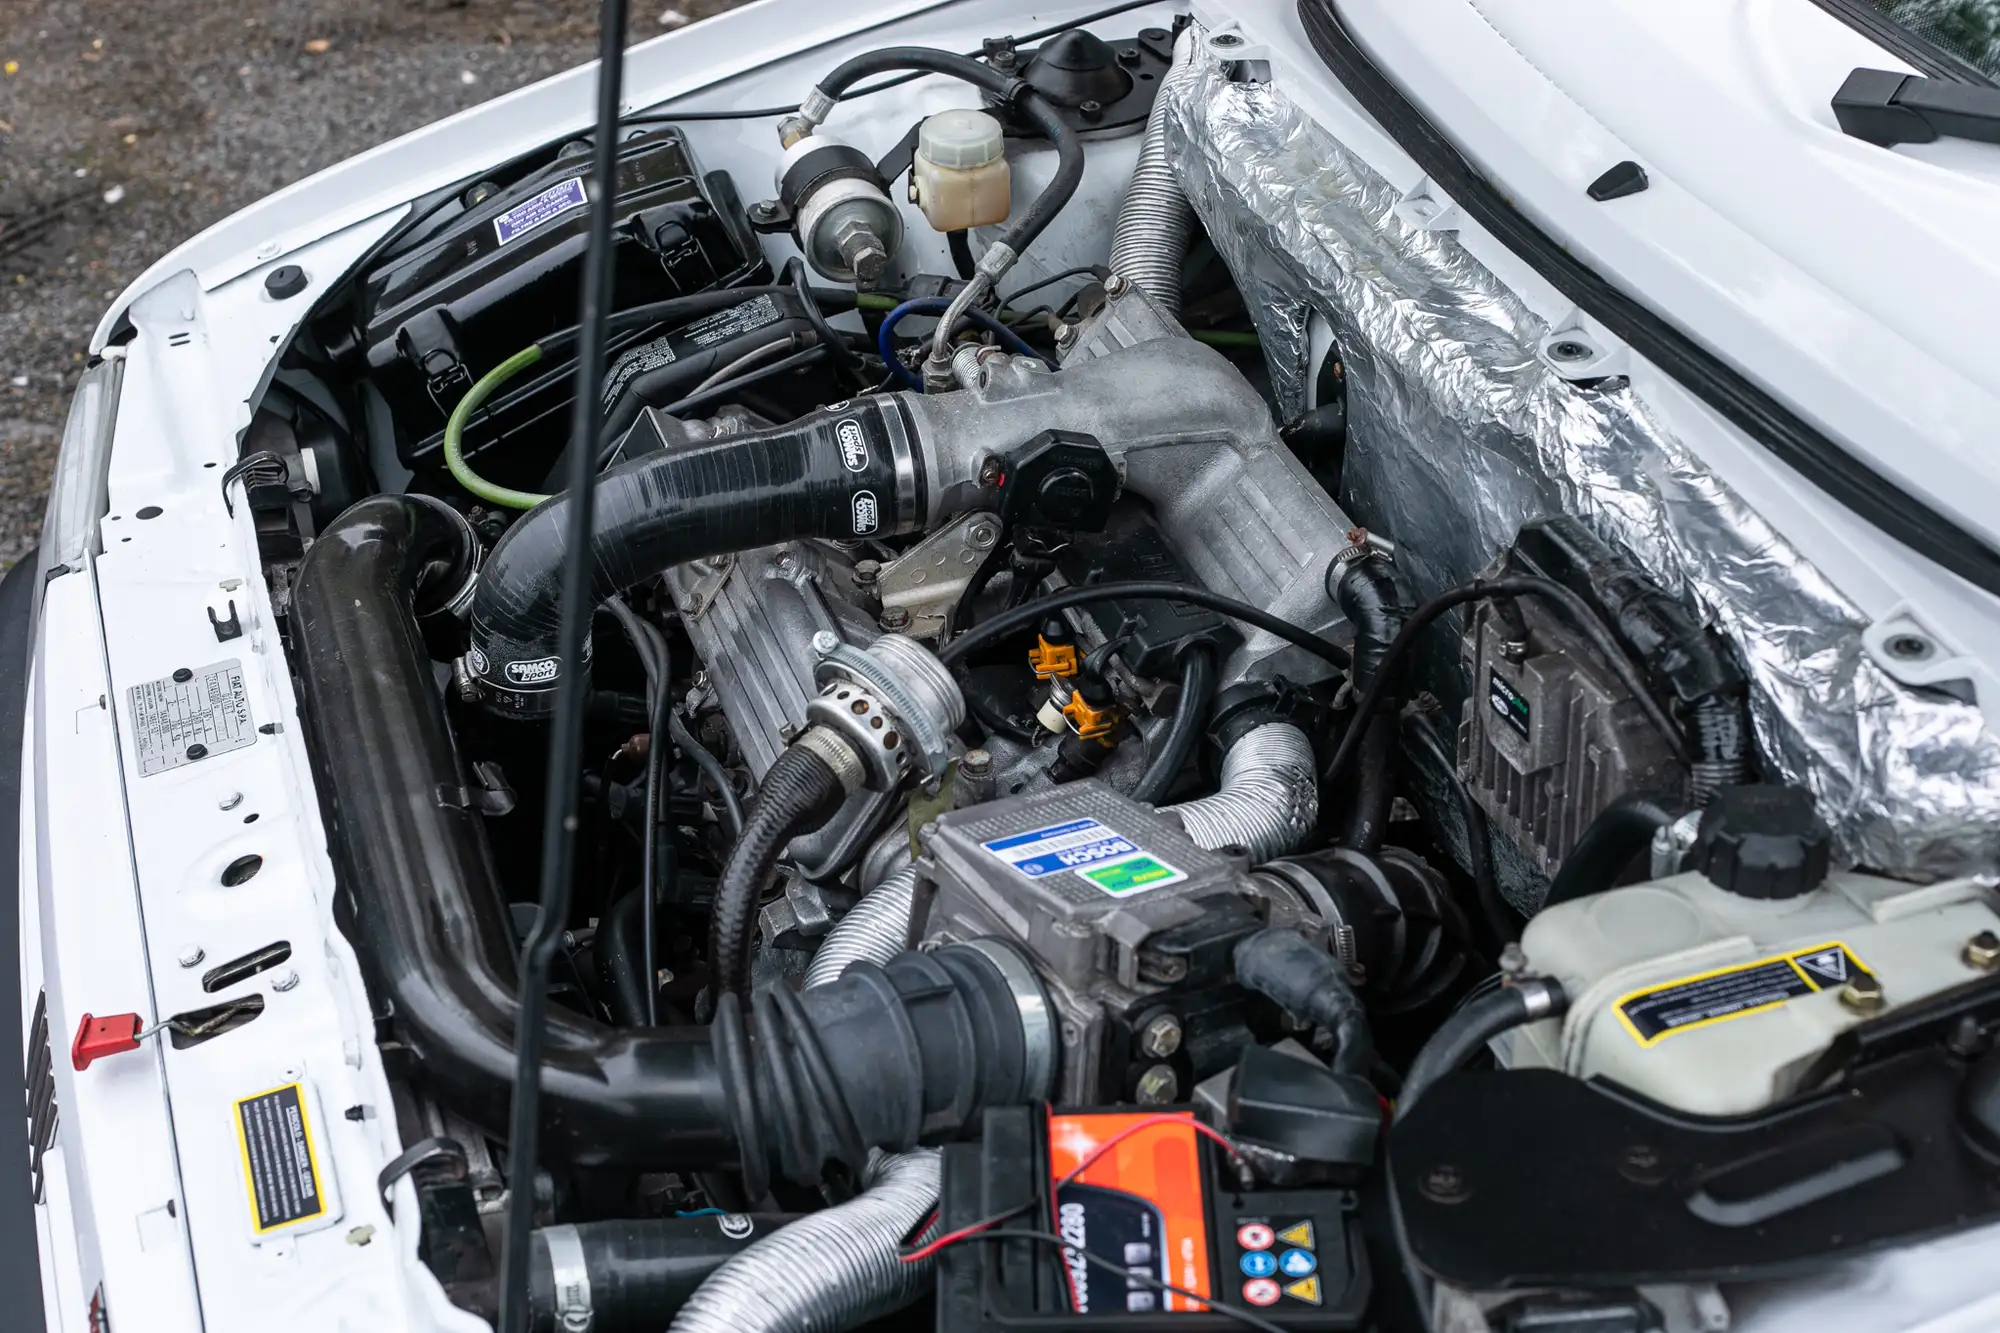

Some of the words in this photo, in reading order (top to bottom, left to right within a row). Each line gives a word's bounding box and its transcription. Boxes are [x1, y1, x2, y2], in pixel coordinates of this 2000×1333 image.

[511, 660, 556, 674] SAMCO
[522, 668, 554, 681] sport
[231, 675, 242, 690] FIAT
[234, 690, 244, 708] AUTO
[1058, 840, 1132, 866] BOSCH
